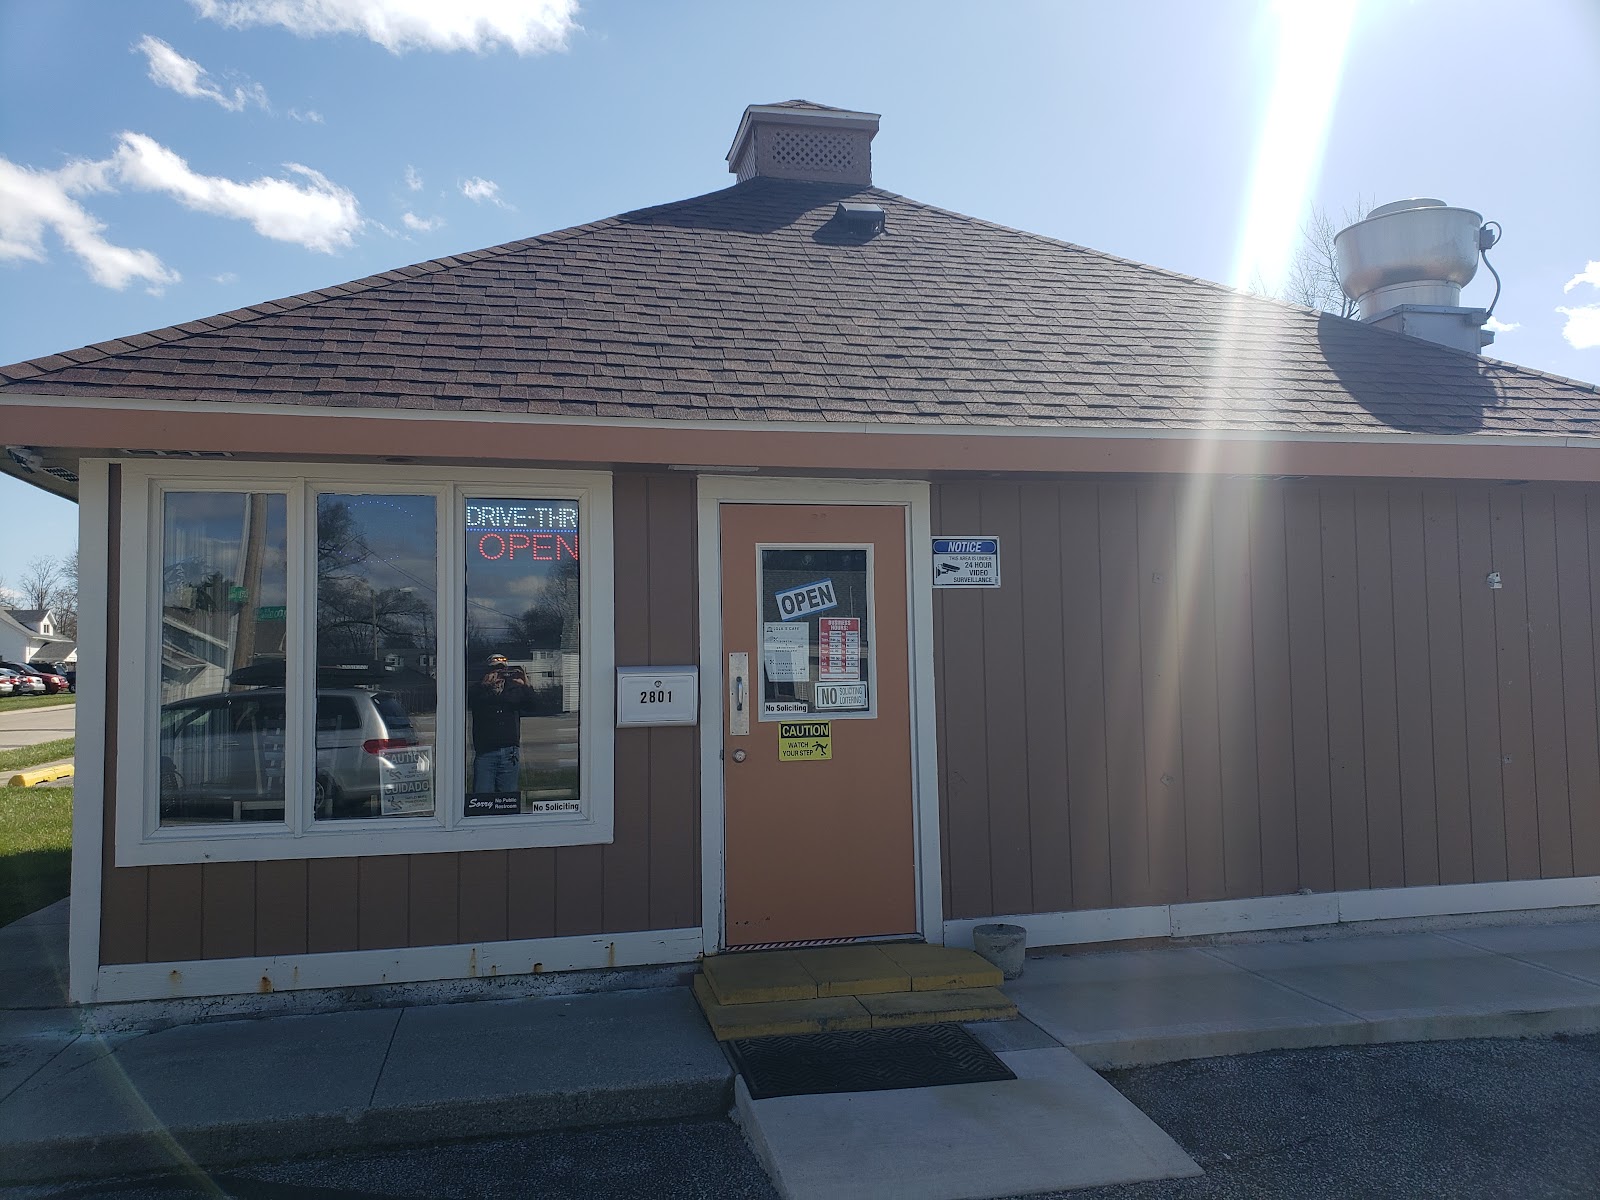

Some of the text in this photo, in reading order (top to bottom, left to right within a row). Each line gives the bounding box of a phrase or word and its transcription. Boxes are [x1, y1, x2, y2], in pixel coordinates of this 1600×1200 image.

[466, 506, 578, 528] DRIVE-THR
[479, 533, 579, 560] OPEN
[947, 541, 982, 553] NOTICE
[781, 584, 834, 615] OPEN
[640, 690, 673, 704] 2801
[821, 687, 838, 705] NO
[839, 686, 863, 696] SOLICITING
[839, 695, 862, 705] LOITERING
[765, 704, 807, 712] No Soliciting
[782, 725, 829, 736] CAUTION
[787, 741, 809, 749] WATCH
[385, 781, 429, 795] CUIDADO
[468, 798, 493, 810] Sorry
[533, 803, 579, 812] No Soliciting
